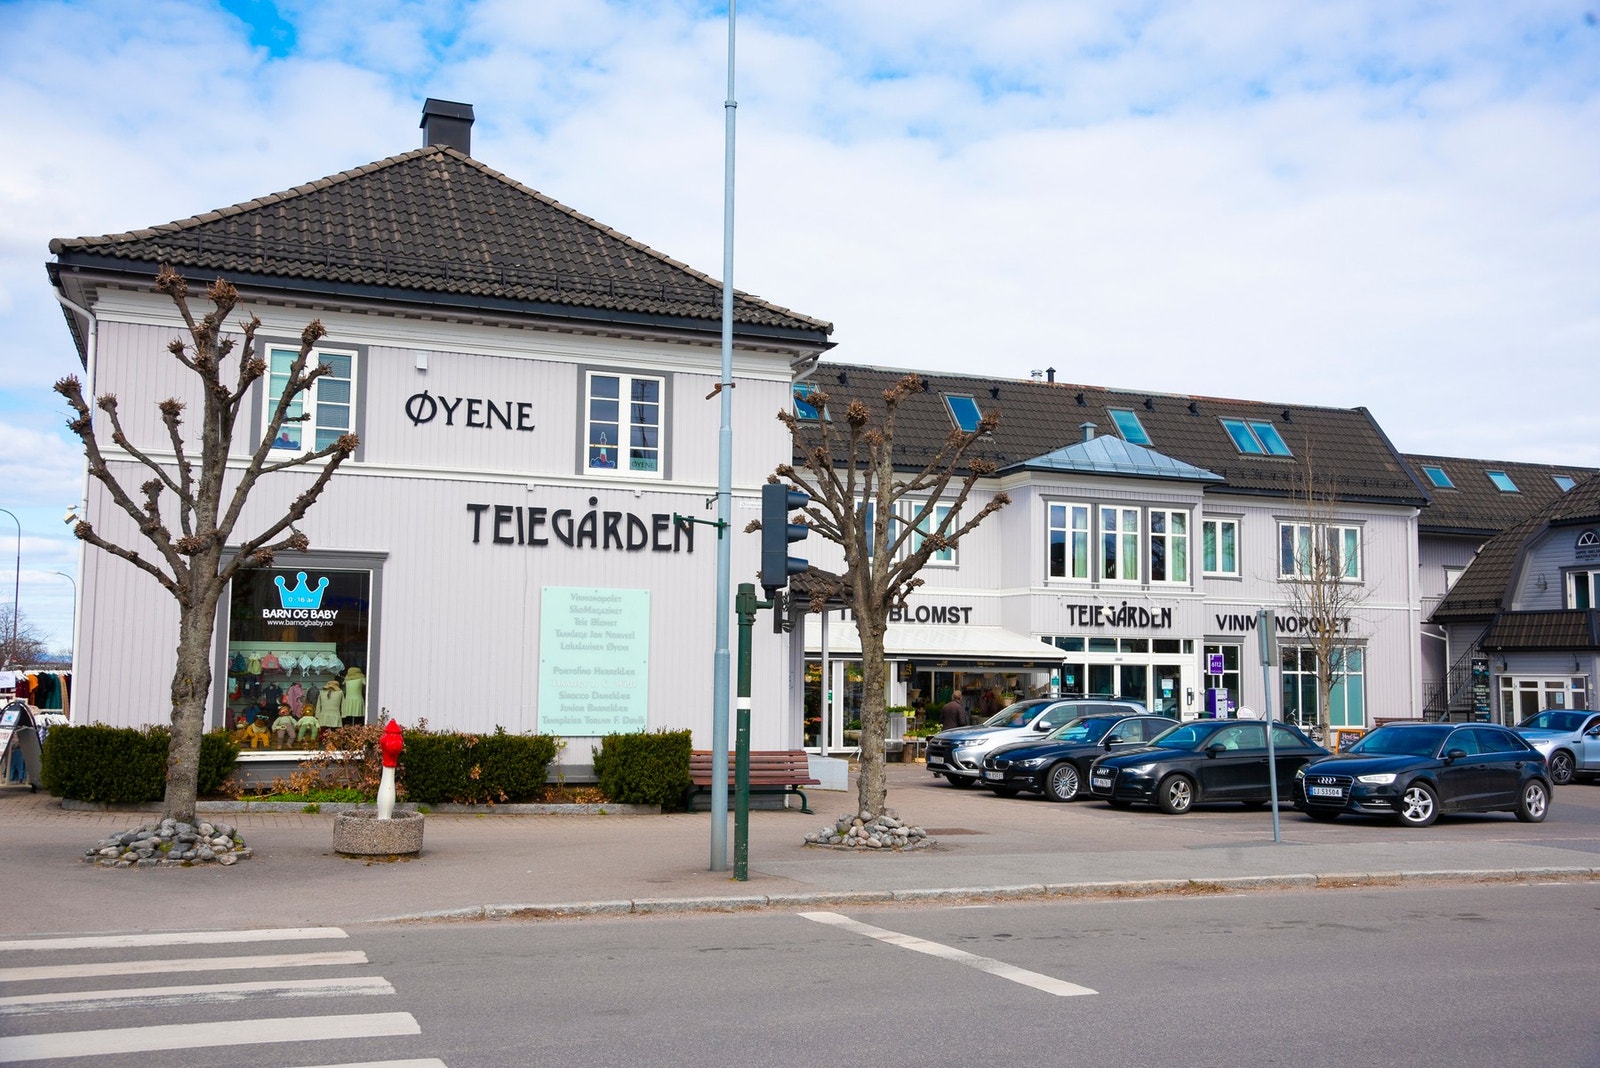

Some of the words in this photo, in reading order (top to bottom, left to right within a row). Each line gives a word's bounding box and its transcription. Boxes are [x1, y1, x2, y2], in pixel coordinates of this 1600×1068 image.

[405, 390, 535, 431] ØYENE
[467, 496, 694, 552] TEIEGÅRDEN
[262, 609, 291, 618] BARN
[293, 609, 308, 619] OG
[310, 609, 338, 619] BABY
[889, 605, 972, 624] BLOMST
[1067, 600, 1171, 628] TEIEGÅRDEN
[1215, 614, 1351, 633] VINMNOPOLET
[267, 620, 333, 628] www.barnogbaby.no
